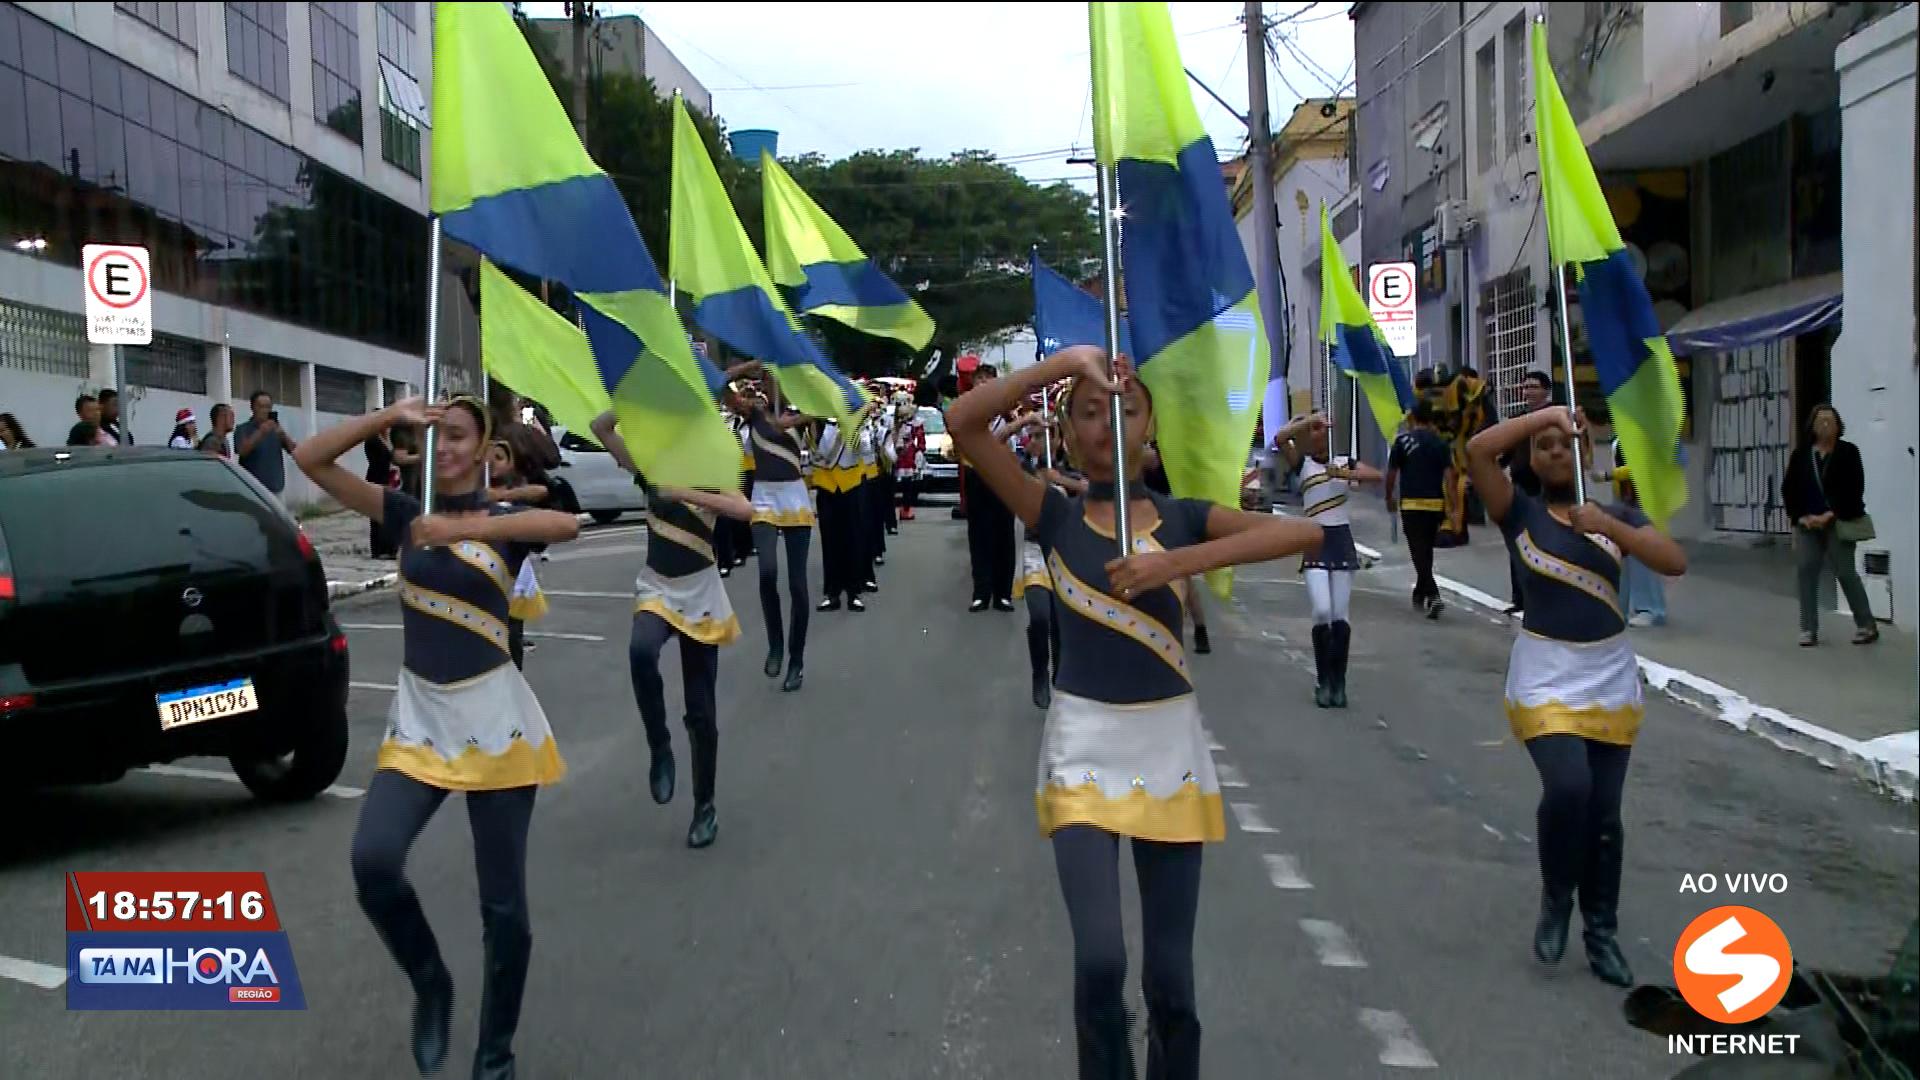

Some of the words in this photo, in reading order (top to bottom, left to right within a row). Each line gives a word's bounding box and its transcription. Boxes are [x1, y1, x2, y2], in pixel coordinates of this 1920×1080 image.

[105, 263, 131, 295] E
[1384, 275, 1402, 299] E
[169, 689, 249, 723] DPN1C96
